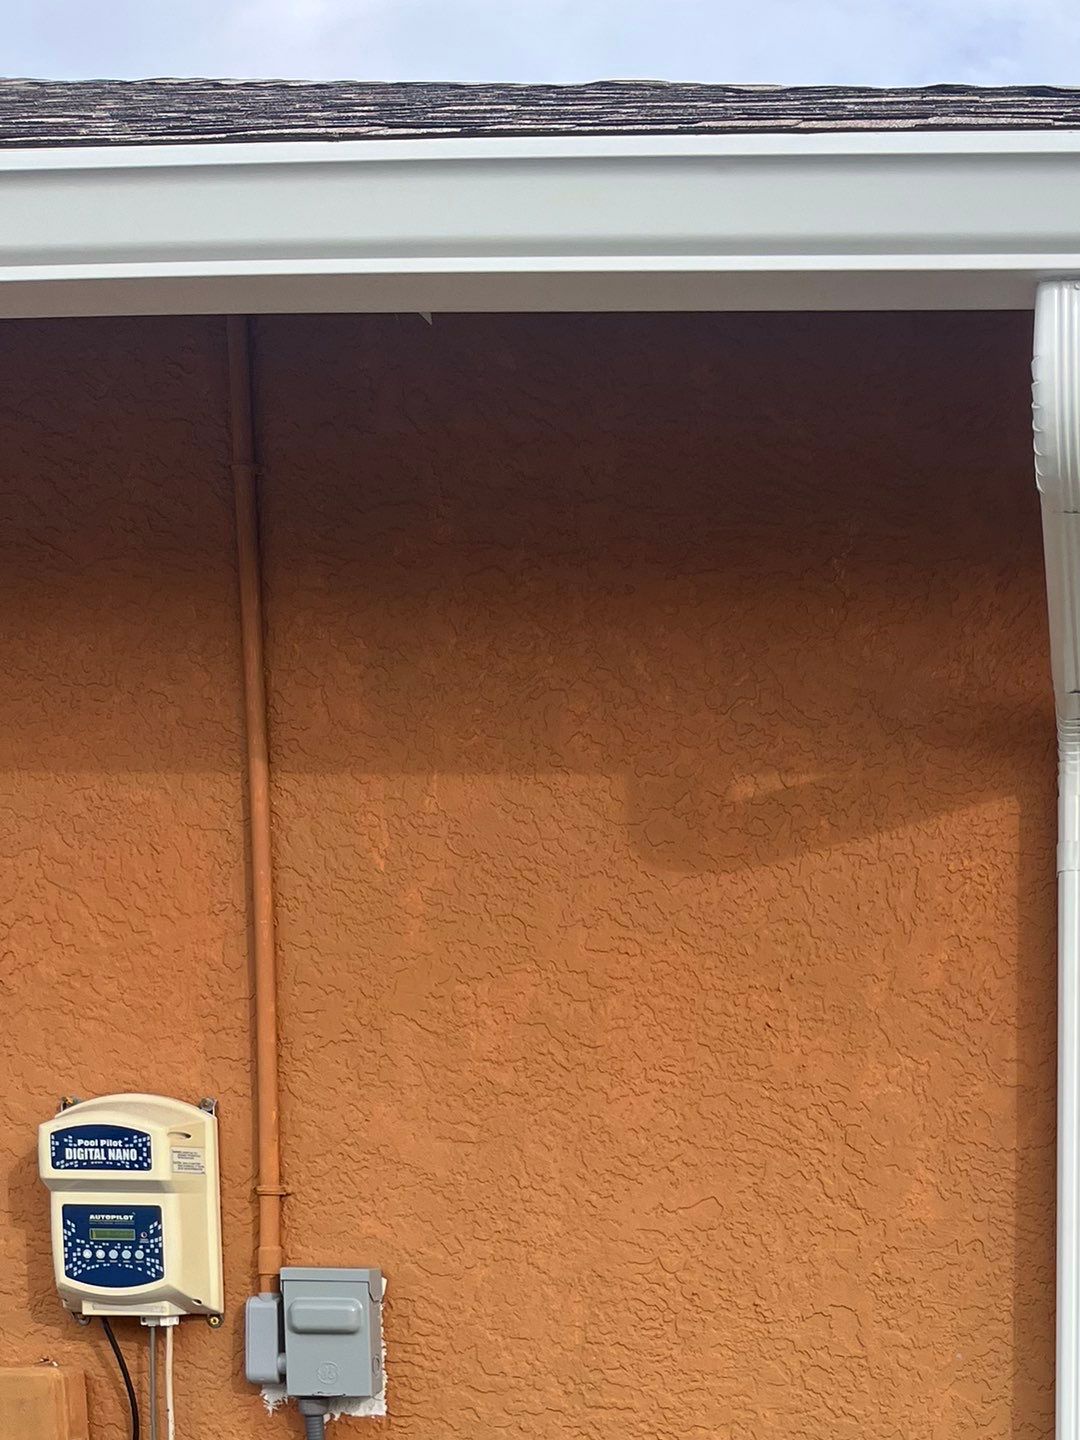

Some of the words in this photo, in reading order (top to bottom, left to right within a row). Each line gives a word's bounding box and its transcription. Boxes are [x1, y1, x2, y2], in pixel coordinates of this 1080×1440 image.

[77, 1139, 98, 1147] Pool
[100, 1139, 123, 1147] Pilot
[65, 1147, 106, 1161] DIGITAL
[108, 1148, 137, 1161] NANO
